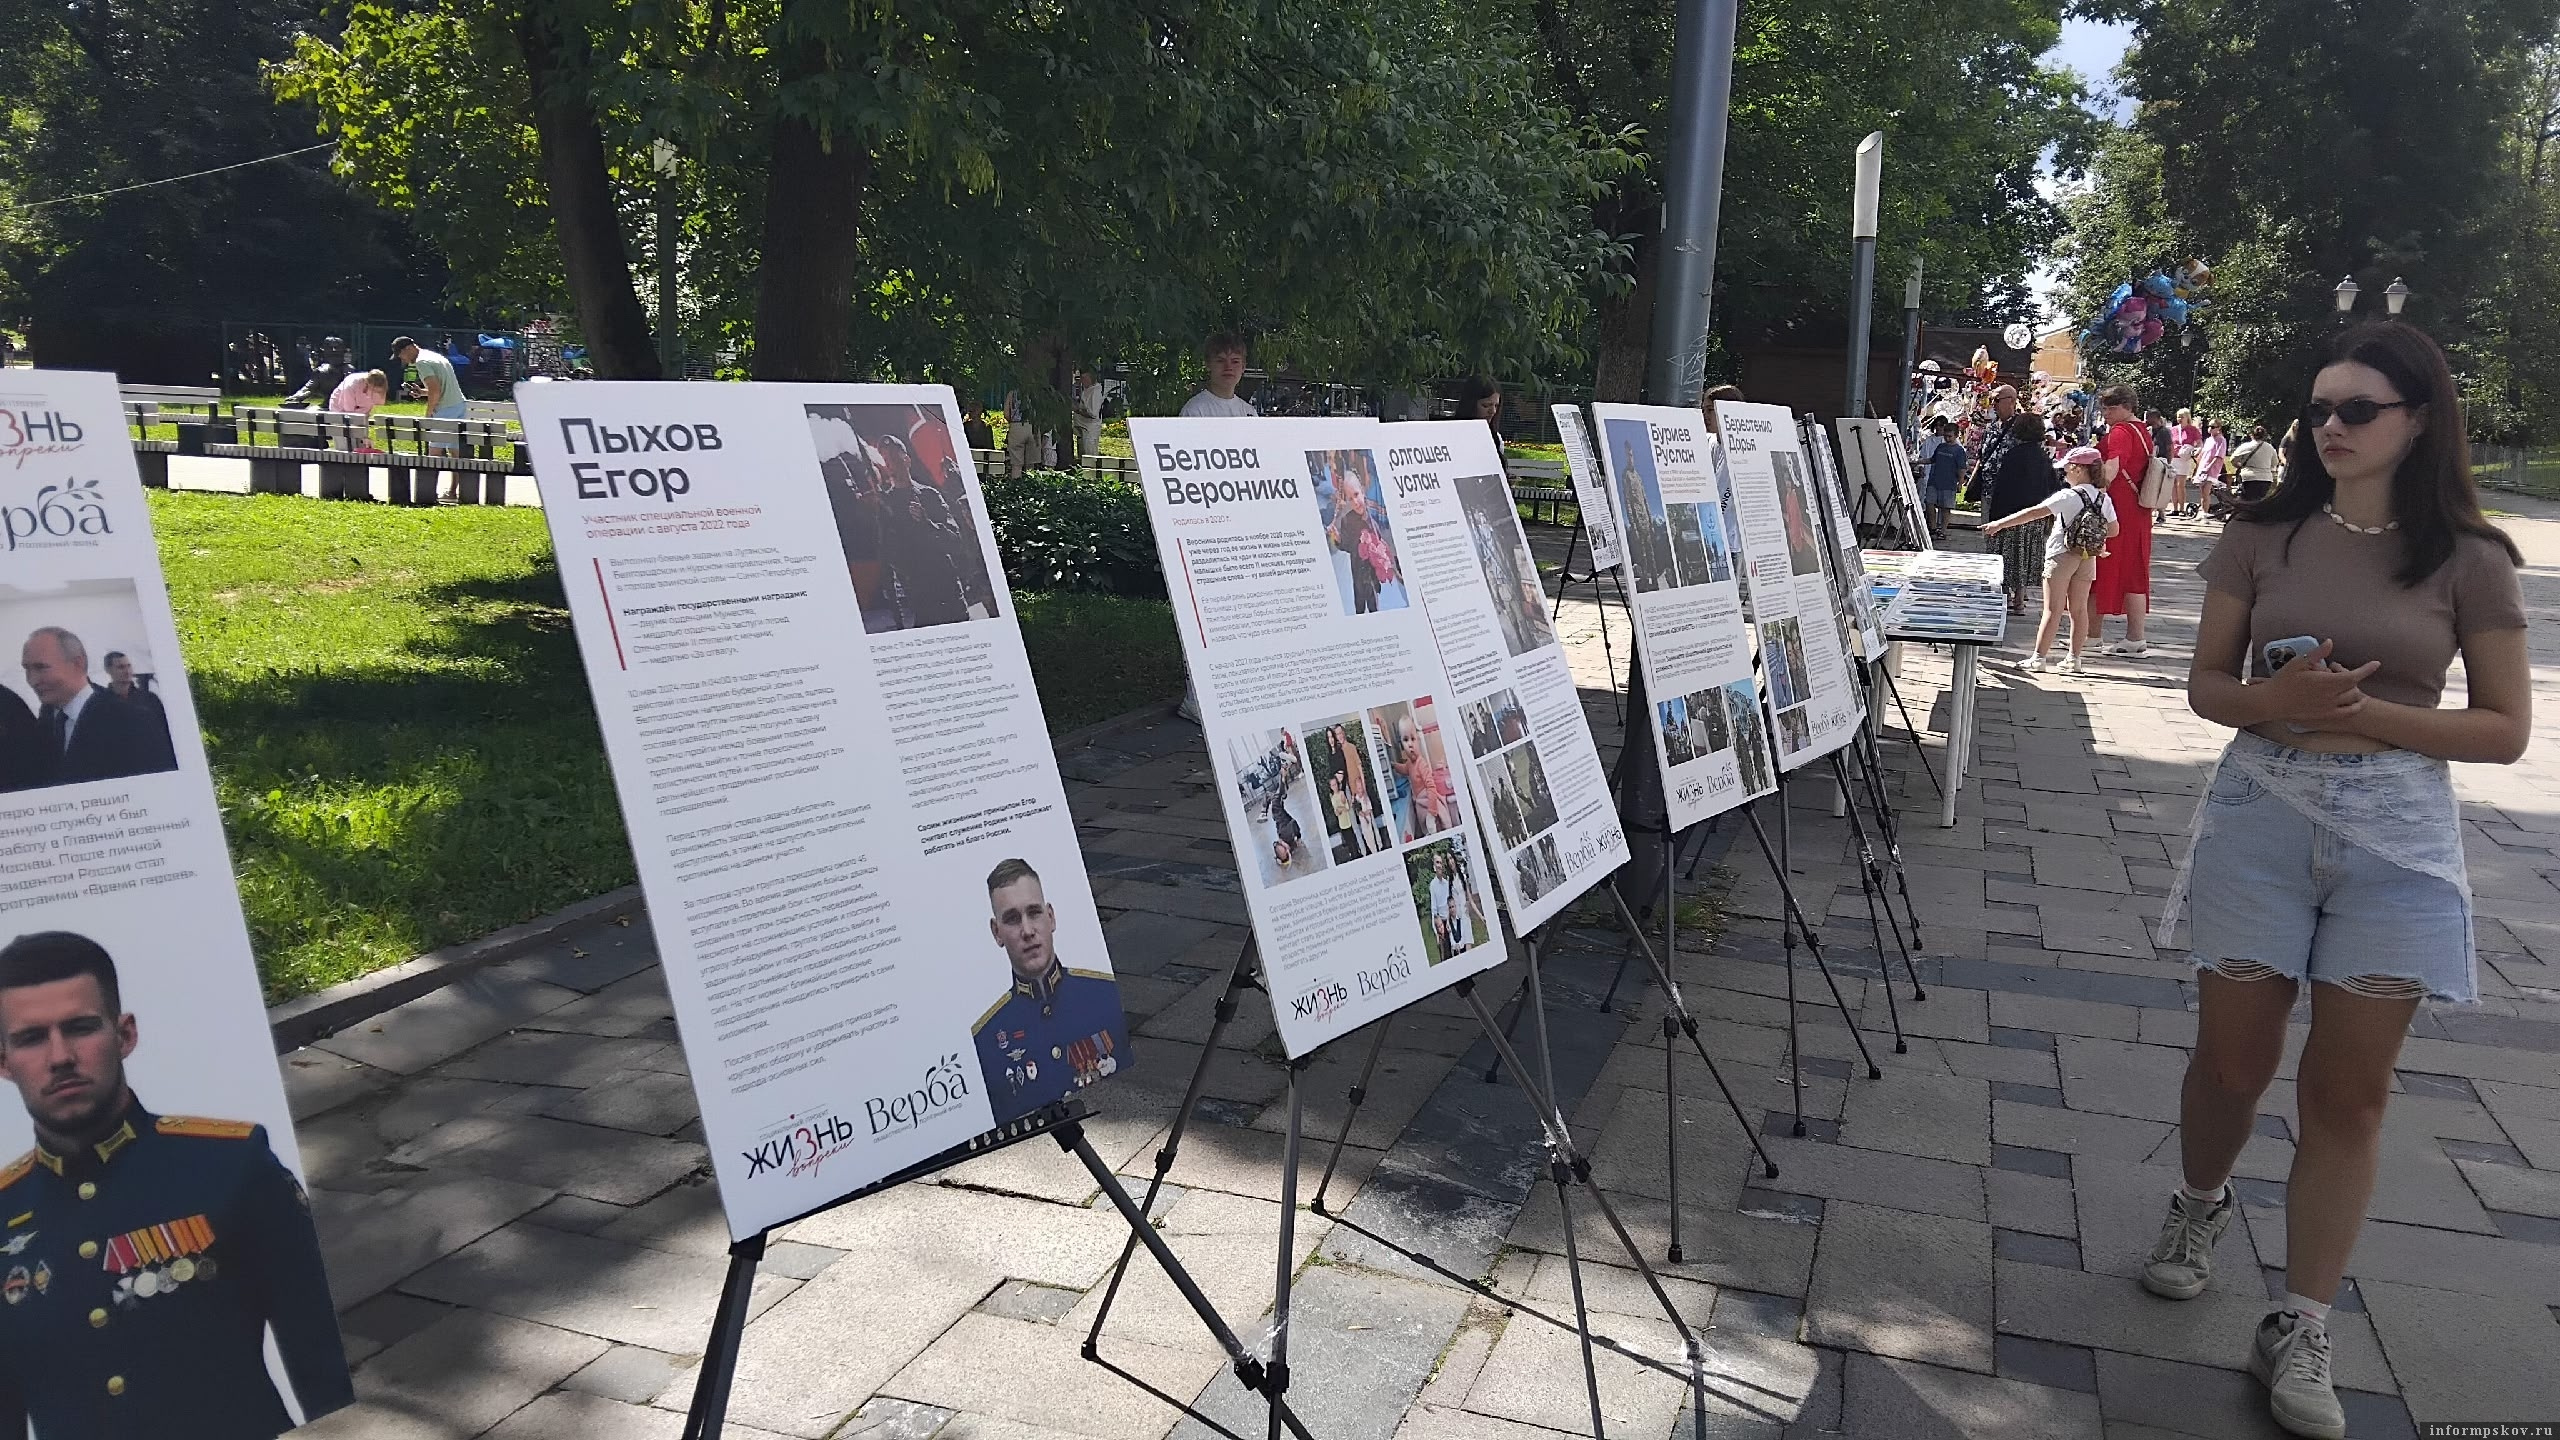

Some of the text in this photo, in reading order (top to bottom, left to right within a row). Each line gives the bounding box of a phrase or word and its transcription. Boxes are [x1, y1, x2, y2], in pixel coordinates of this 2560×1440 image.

[560, 418, 722, 454] Пыхов
[1727, 433, 1757, 454] Дарья
[1154, 443, 1260, 471] Белова
[1389, 445, 1452, 471] олгошея
[1654, 444, 1696, 467] Руслан
[571, 462, 690, 502] Егор
[1163, 477, 1298, 508] Вероника
[1393, 472, 1441, 498] услан
[581, 504, 761, 523] Участник специальной военной
[1172, 517, 1205, 526] Родилась
[1209, 514, 1225, 522] 2020
[586, 527, 645, 539] операции
[656, 524, 698, 534] августа
[699, 520, 724, 529] 2022
[726, 520, 750, 529] года
[1186, 538, 1216, 546] Вероника
[622, 591, 808, 616] Награждён государственными наградами:
[39, 802, 77, 814] ноги,
[81, 794, 130, 811] решил
[917, 797, 1036, 831] Своим жизненным принципом Егор
[50, 813, 102, 831] службу
[107, 814, 116, 822] и
[119, 808, 148, 820] был
[920, 832, 948, 842] считает
[948, 823, 983, 836] служение
[983, 816, 1008, 827] Родине
[1014, 805, 1052, 819] продолжает
[51, 839, 59, 849] в
[63, 829, 124, 846] Главный
[128, 818, 190, 836] военный
[923, 842, 955, 856] работать
[985, 827, 1011, 838] России.
[59, 851, 105, 864] После
[109, 839, 162, 857] личной
[78, 864, 131, 879] России
[135, 858, 165, 870] стал
[83, 879, 136, 896] «Время
[1356, 946, 1411, 996] Верба
[1290, 983, 1348, 1021] ЖИЗНЬ
[864, 1054, 969, 1135] Верба
[741, 1116, 853, 1179] ЖИЗНЬ
